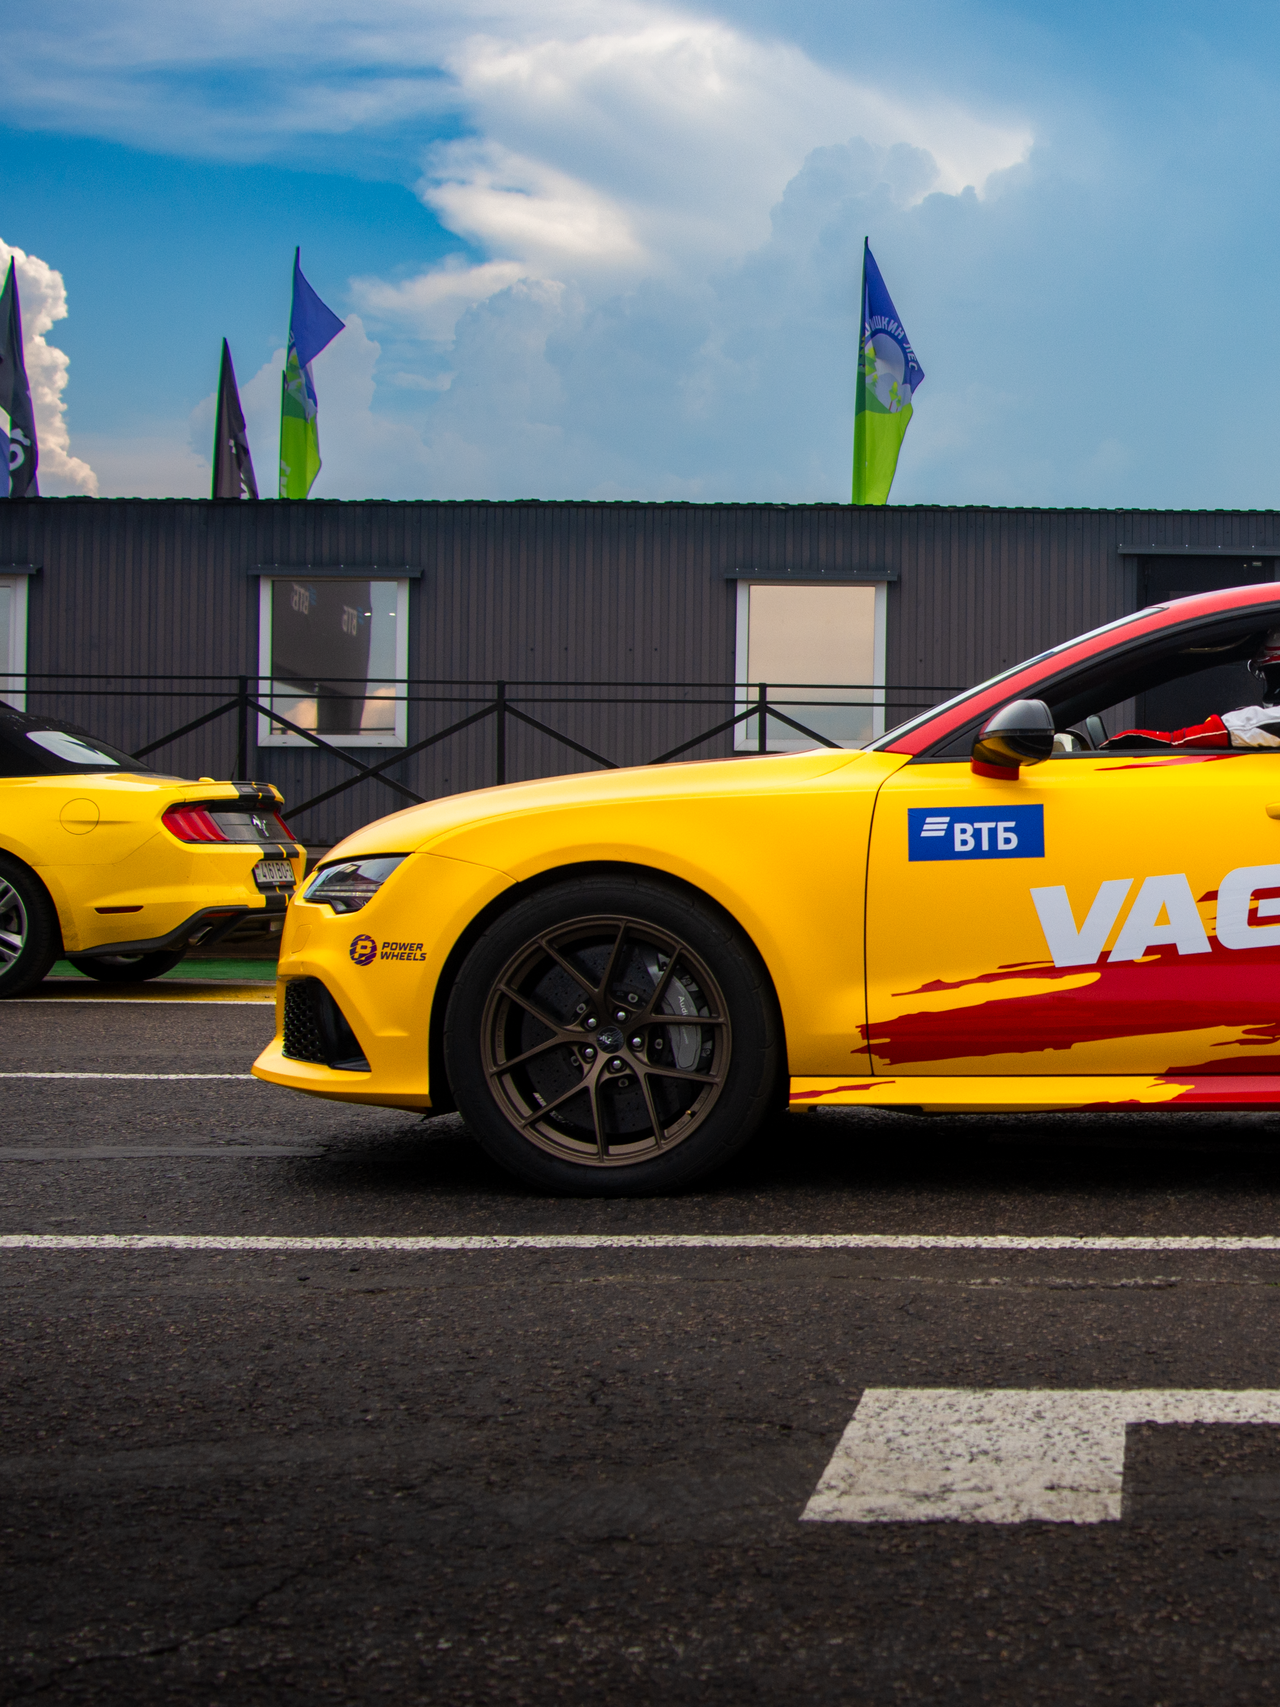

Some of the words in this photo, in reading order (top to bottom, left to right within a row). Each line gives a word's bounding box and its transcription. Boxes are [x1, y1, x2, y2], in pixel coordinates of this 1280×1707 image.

[903, 343, 918, 371] ЛЕС
[954, 821, 1019, 852] ВТБ
[381, 941, 424, 952] POWER
[380, 951, 428, 962] WHEELS
